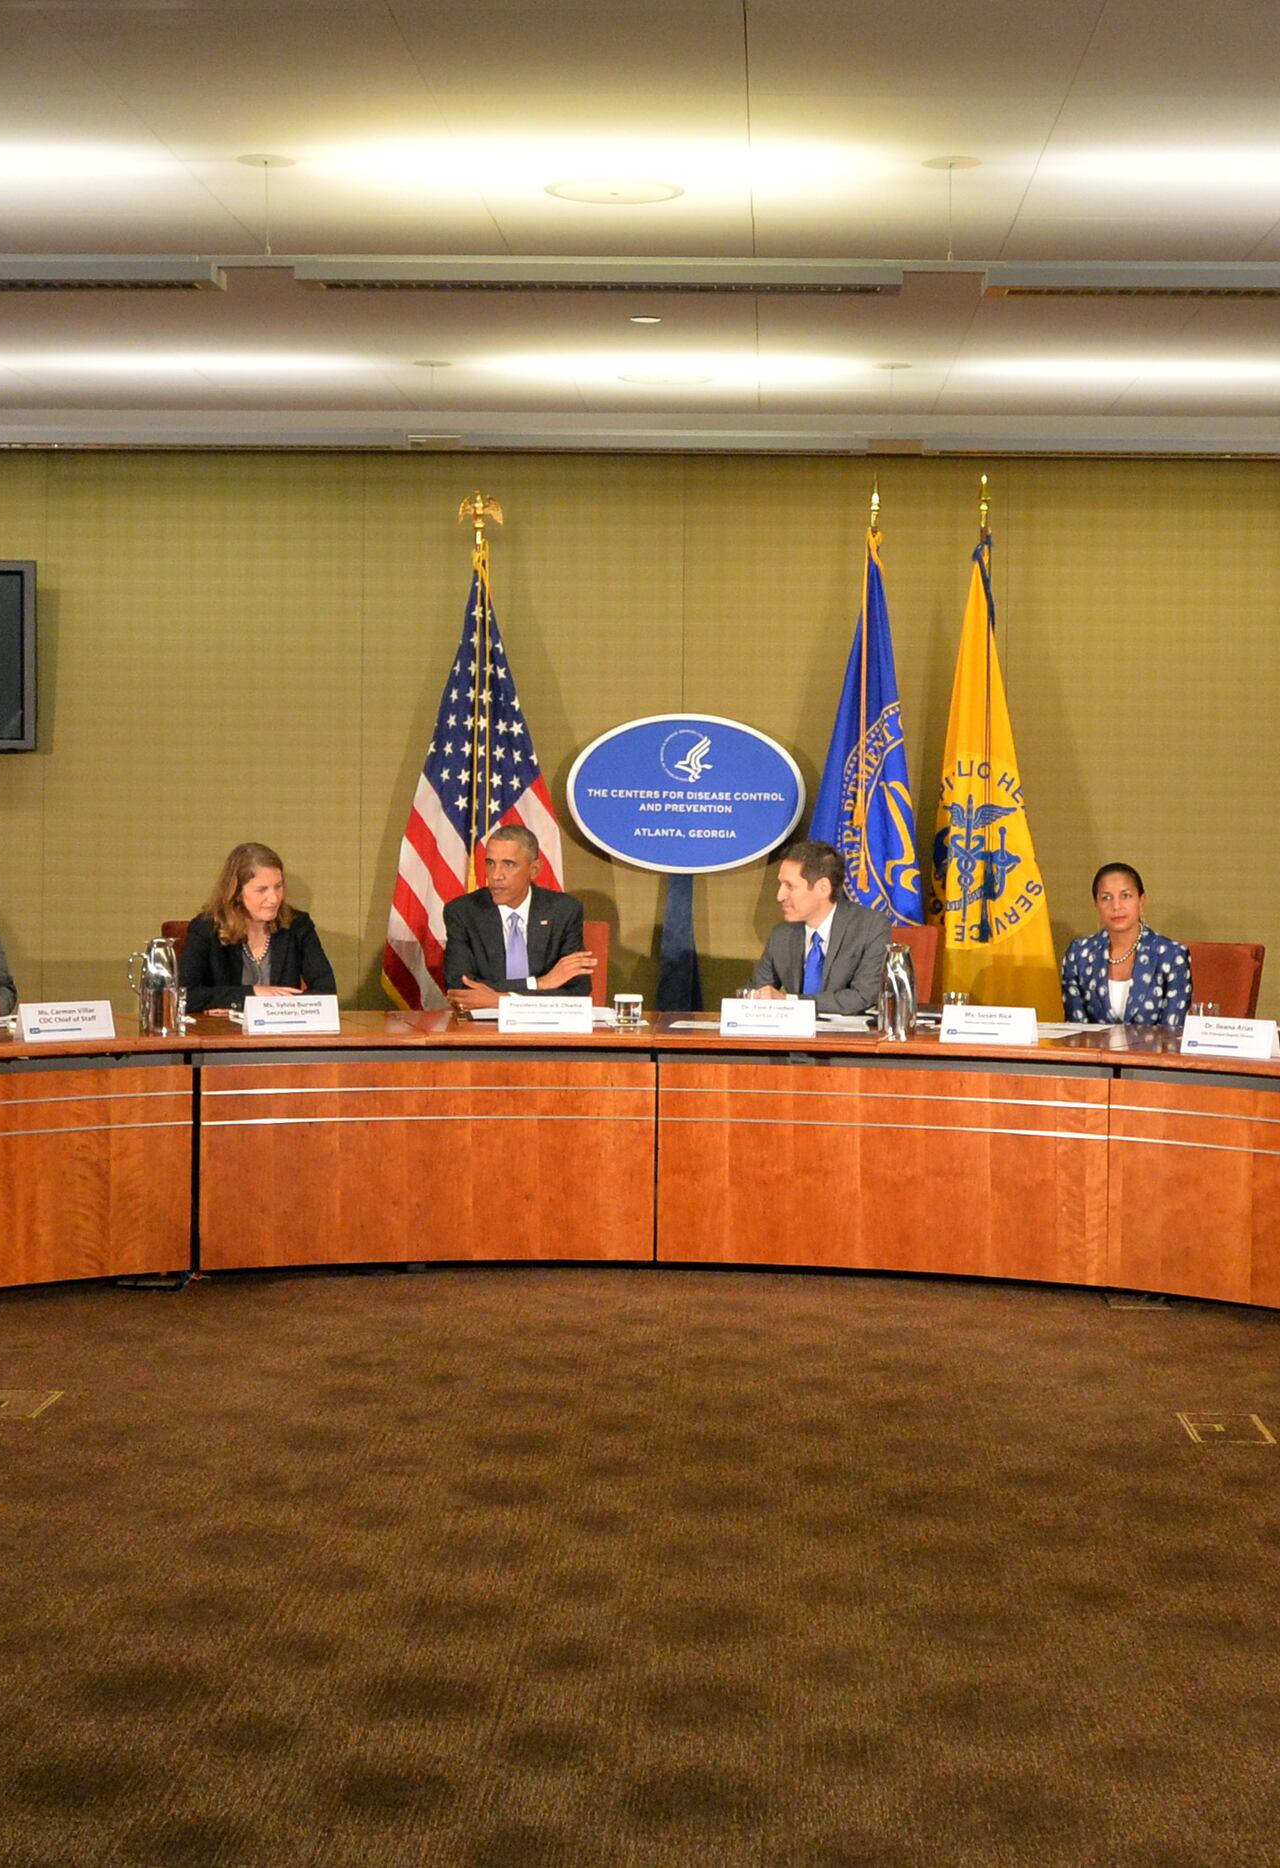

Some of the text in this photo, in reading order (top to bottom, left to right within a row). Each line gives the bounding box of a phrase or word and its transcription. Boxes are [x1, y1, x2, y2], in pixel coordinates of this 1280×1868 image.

[587, 789, 785, 802] THE CENTERS FOR DISEASE CONTROL
[639, 803, 733, 814] AND PREVENTION
[633, 828, 736, 839] ATLANTA, GEORGIA
[954, 880, 1043, 942] SERVCE
[81, 1014, 97, 1022] Staff
[1237, 1024, 1254, 1032] Arias
